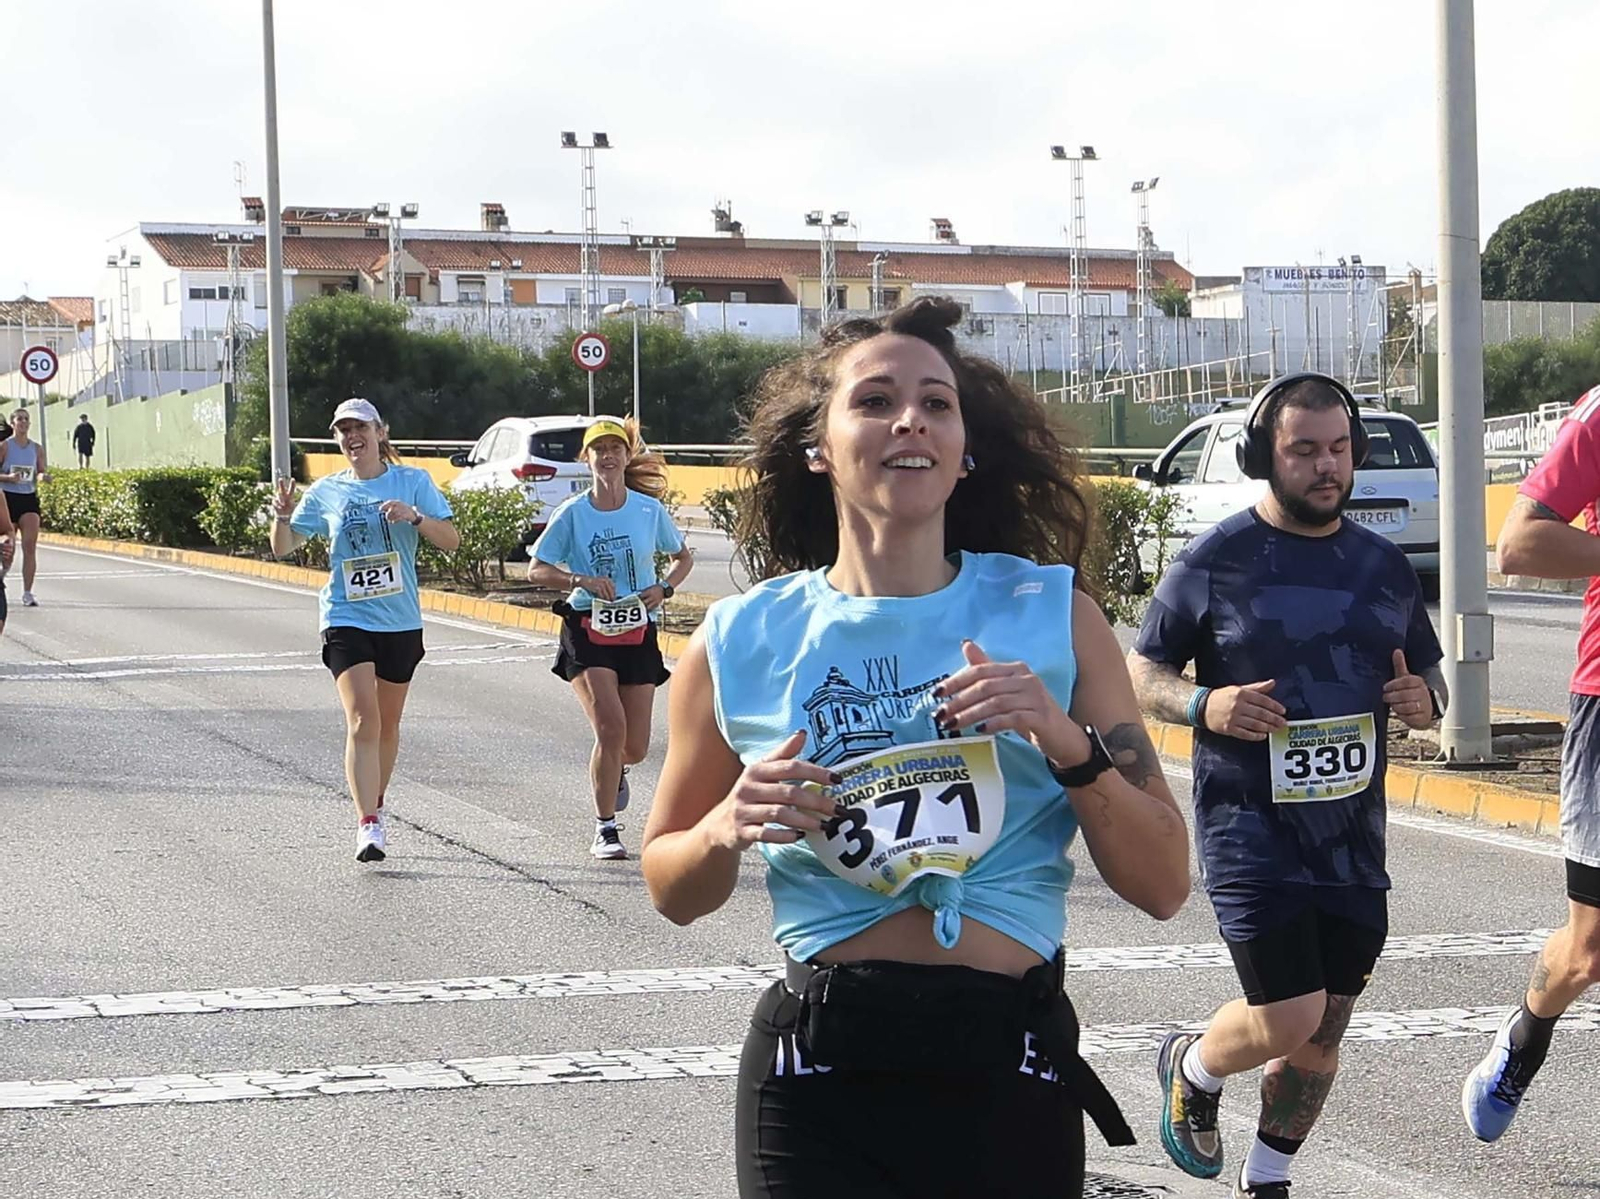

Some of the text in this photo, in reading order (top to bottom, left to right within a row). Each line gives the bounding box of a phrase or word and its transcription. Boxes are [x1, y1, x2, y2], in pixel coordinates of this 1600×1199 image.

[581, 345, 603, 359] 50
[29, 358, 51, 372] 50
[1376, 511, 1397, 523] CFL
[350, 566, 395, 587] 421
[598, 607, 642, 624] 369
[863, 654, 898, 692] XXV
[1288, 731, 1362, 749] CIUDAD DE ALGECIRAS
[895, 755, 967, 775] URBANA
[1284, 742, 1367, 779] 330
[836, 768, 971, 808] UDAD DE ALGECIRAS
[824, 782, 982, 870] 371
[869, 849, 888, 871] PÉREZ
